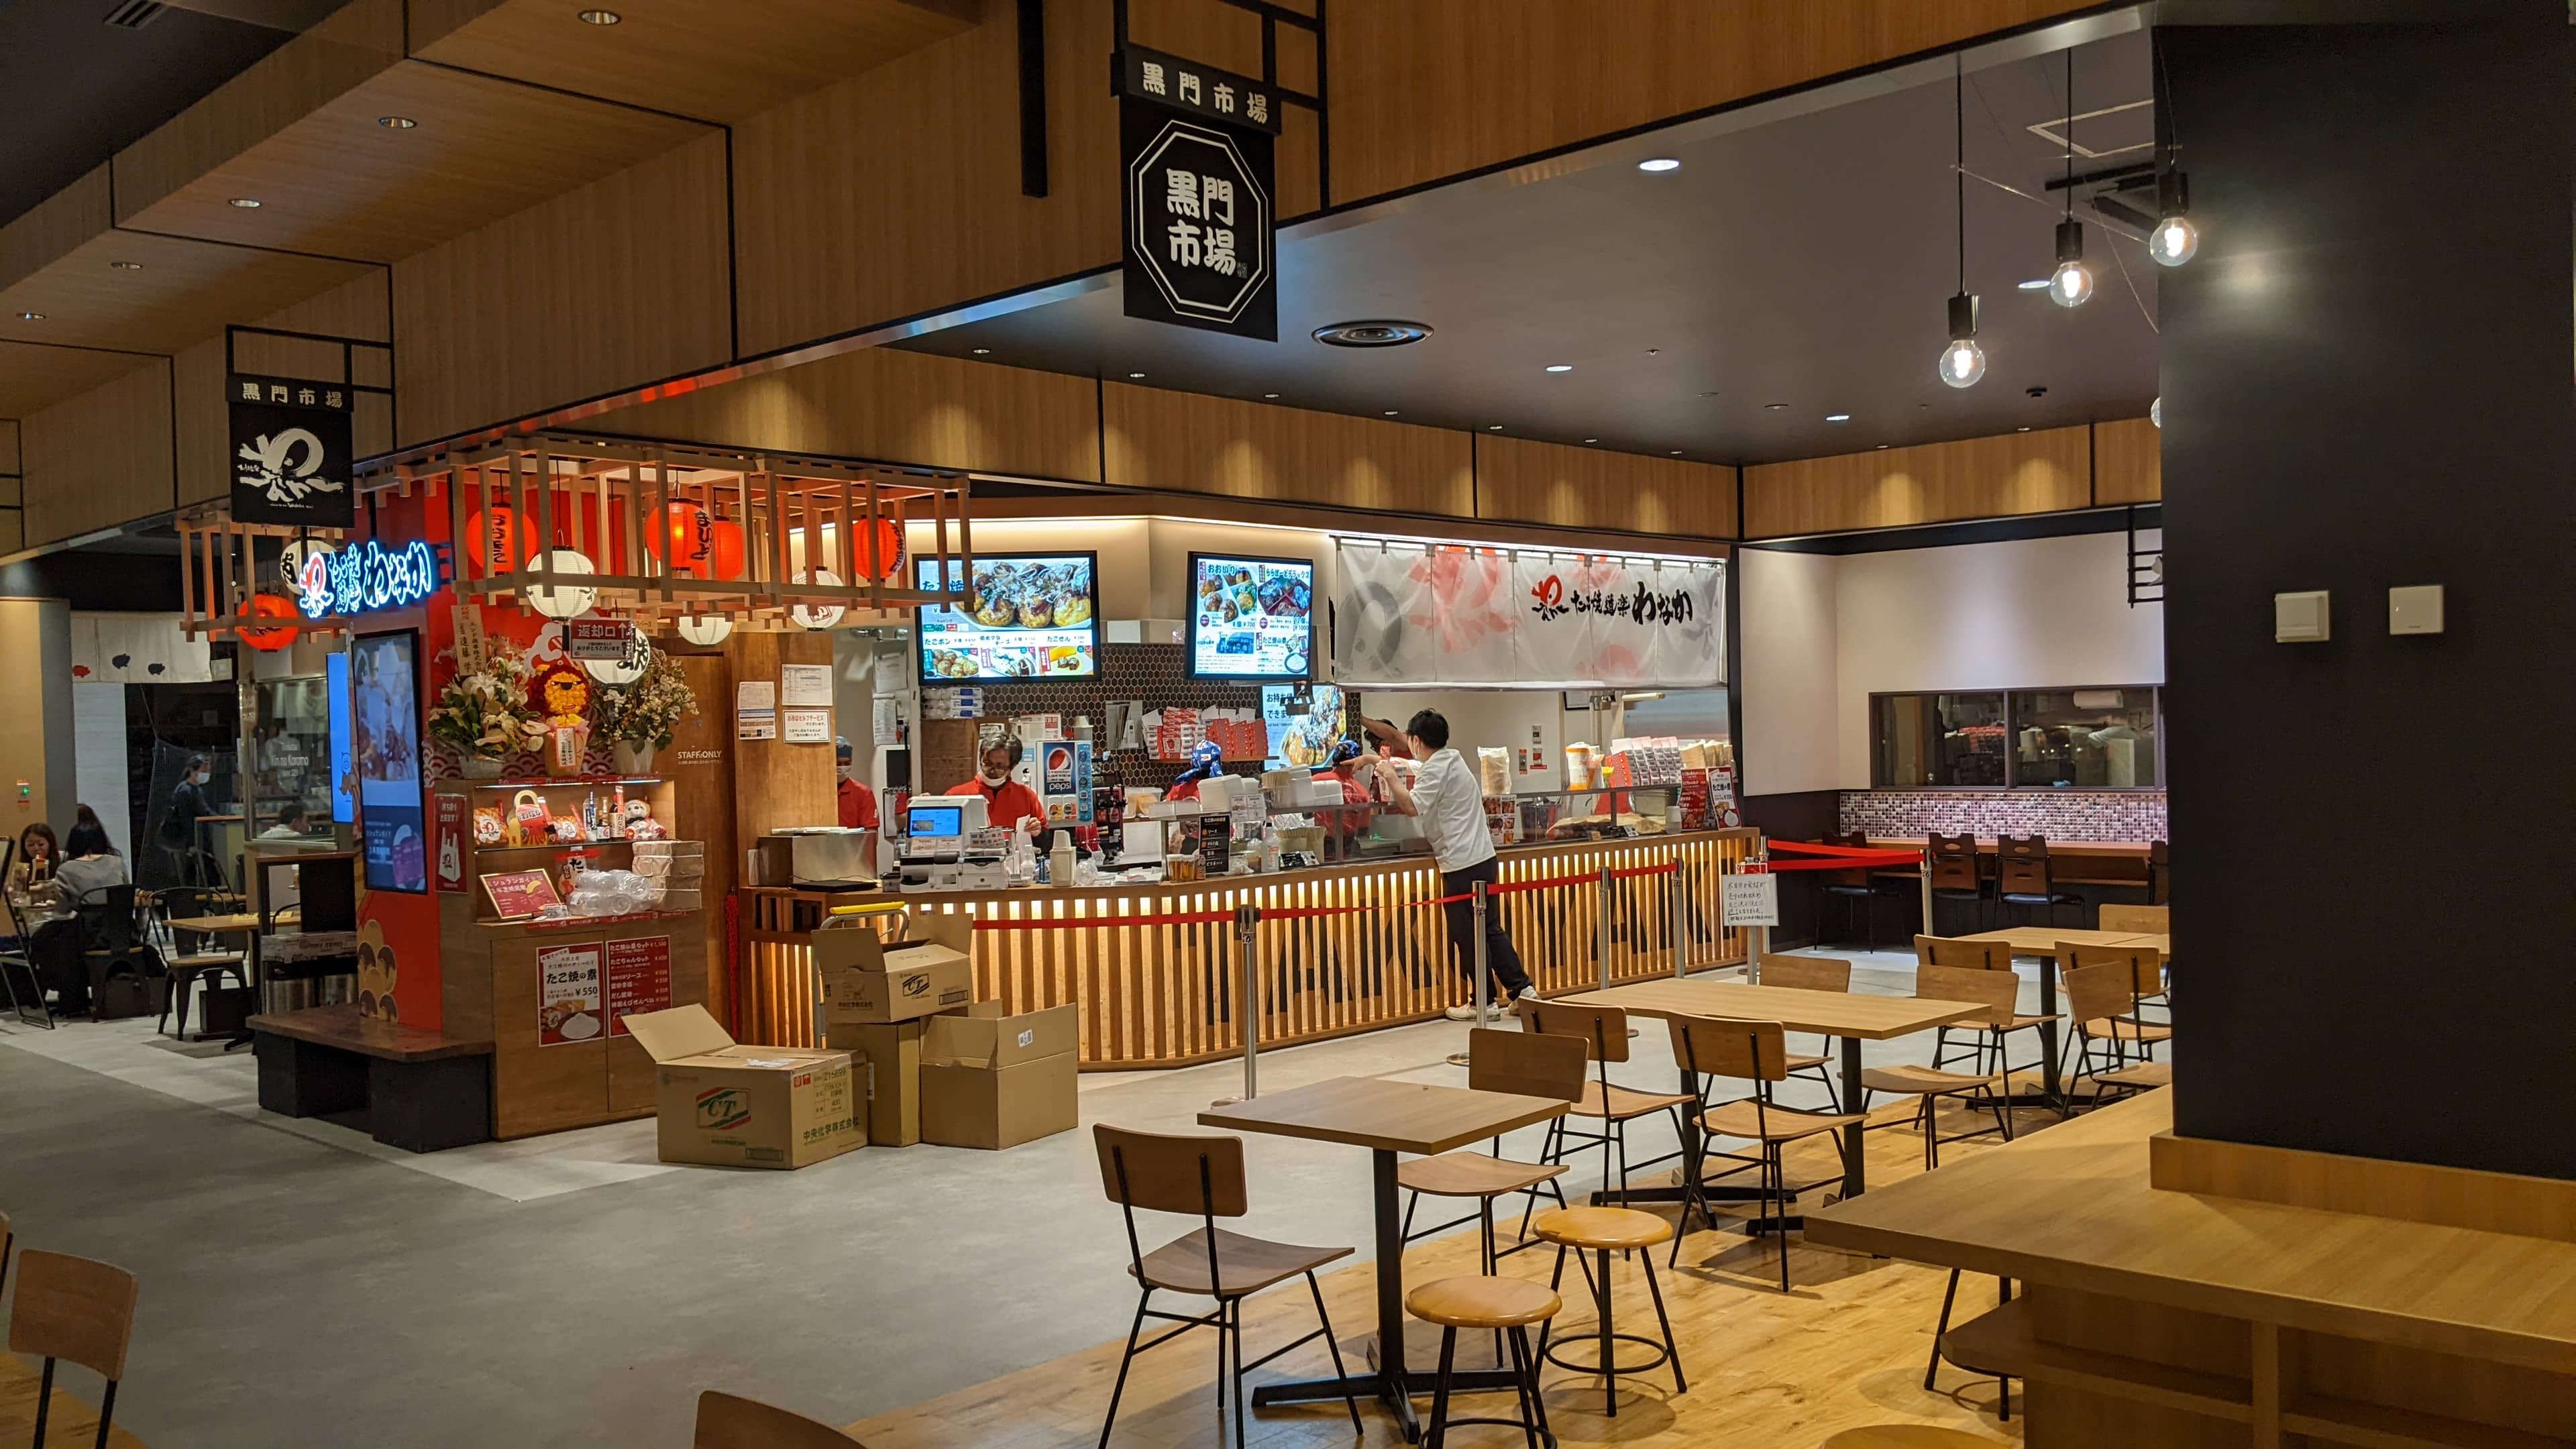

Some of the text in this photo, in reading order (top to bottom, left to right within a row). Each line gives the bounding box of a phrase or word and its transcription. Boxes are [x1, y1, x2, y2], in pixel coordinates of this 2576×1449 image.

[1142, 61, 1268, 125] 黒門市場
[1166, 168, 1234, 227] 黒門
[1167, 219, 1237, 276] 市場
[242, 382, 343, 409] 黒門市場
[362, 541, 432, 608] わなか
[1570, 581, 1693, 626] たこ焼道楽 わなか
[578, 624, 616, 638] 返却口
[678, 750, 722, 759] STAFF ONLY
[1049, 783, 1072, 792] pepsi
[546, 968, 597, 984] たこ焼の素
[908, 979, 924, 991] CT
[575, 986, 598, 996] ¥550
[708, 1099, 737, 1118] CT
[803, 1116, 859, 1141] 中央化学株式会社
